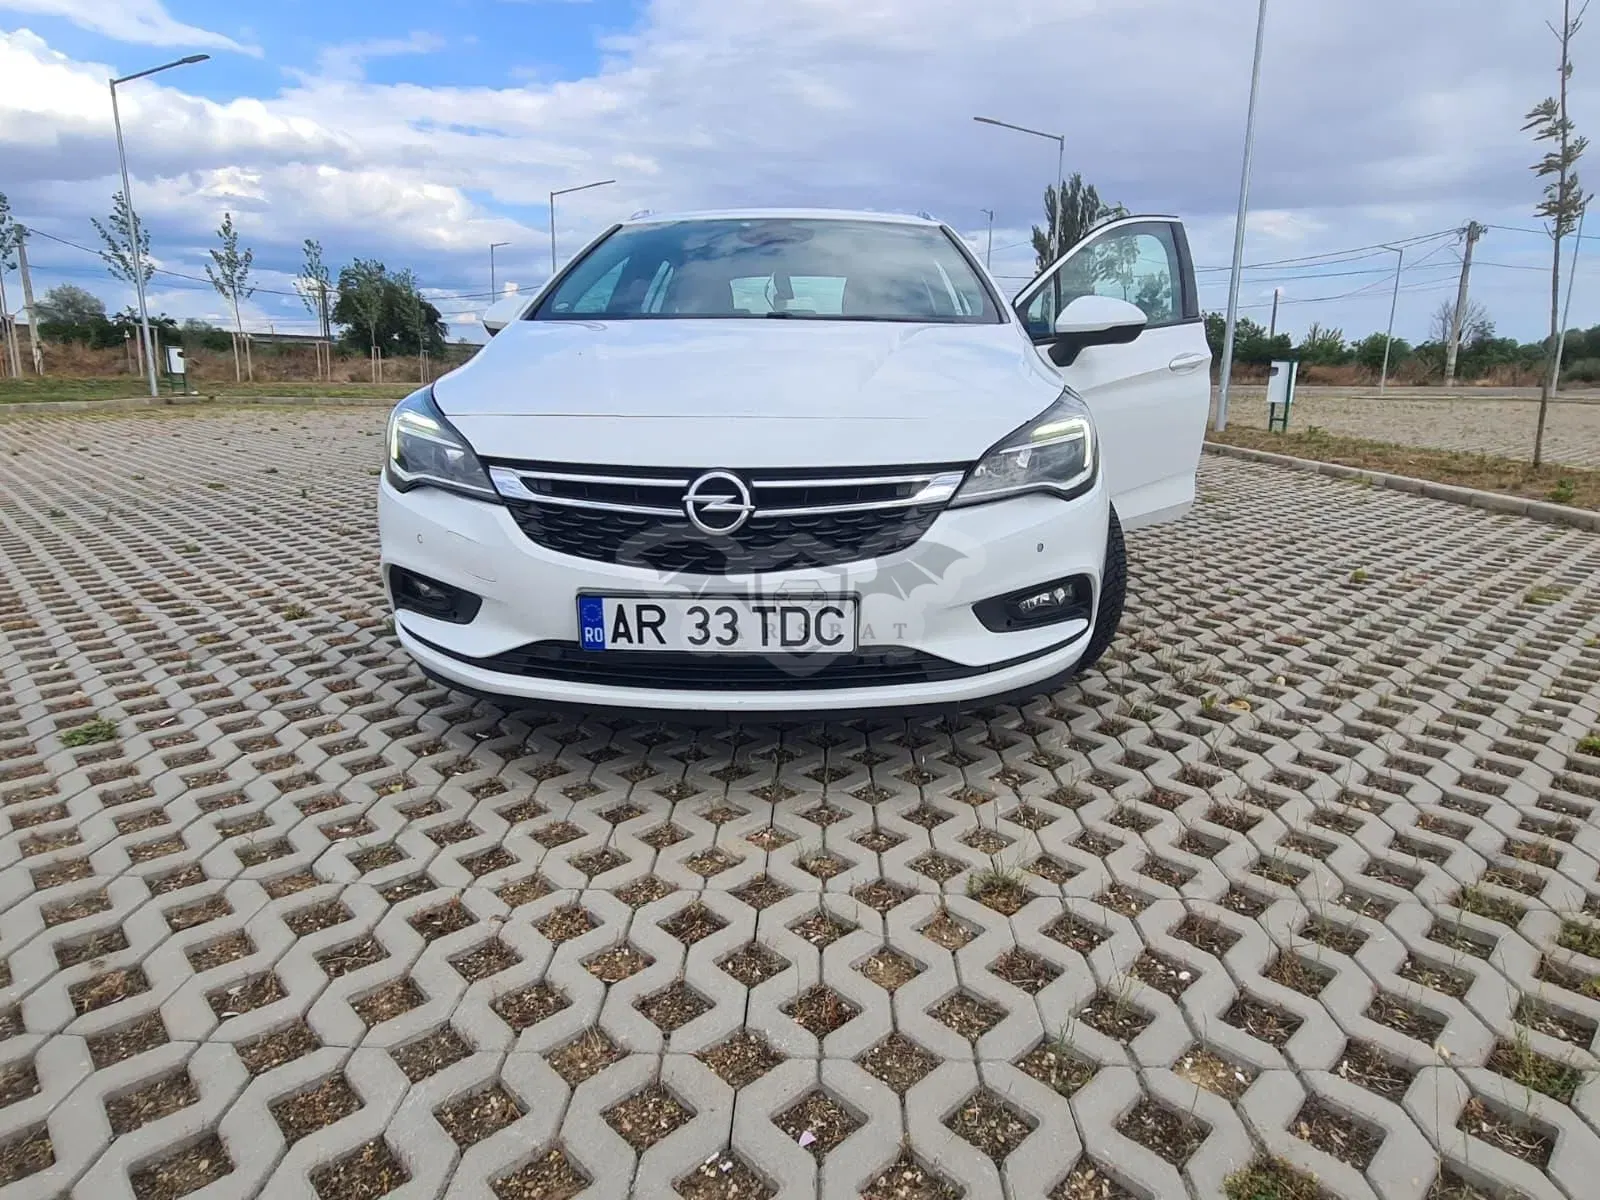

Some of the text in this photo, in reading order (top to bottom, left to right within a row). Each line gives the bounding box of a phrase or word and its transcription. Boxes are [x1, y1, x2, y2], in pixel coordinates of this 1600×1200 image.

[584, 627, 603, 642] RO
[611, 604, 845, 646] AR 33 TDC
